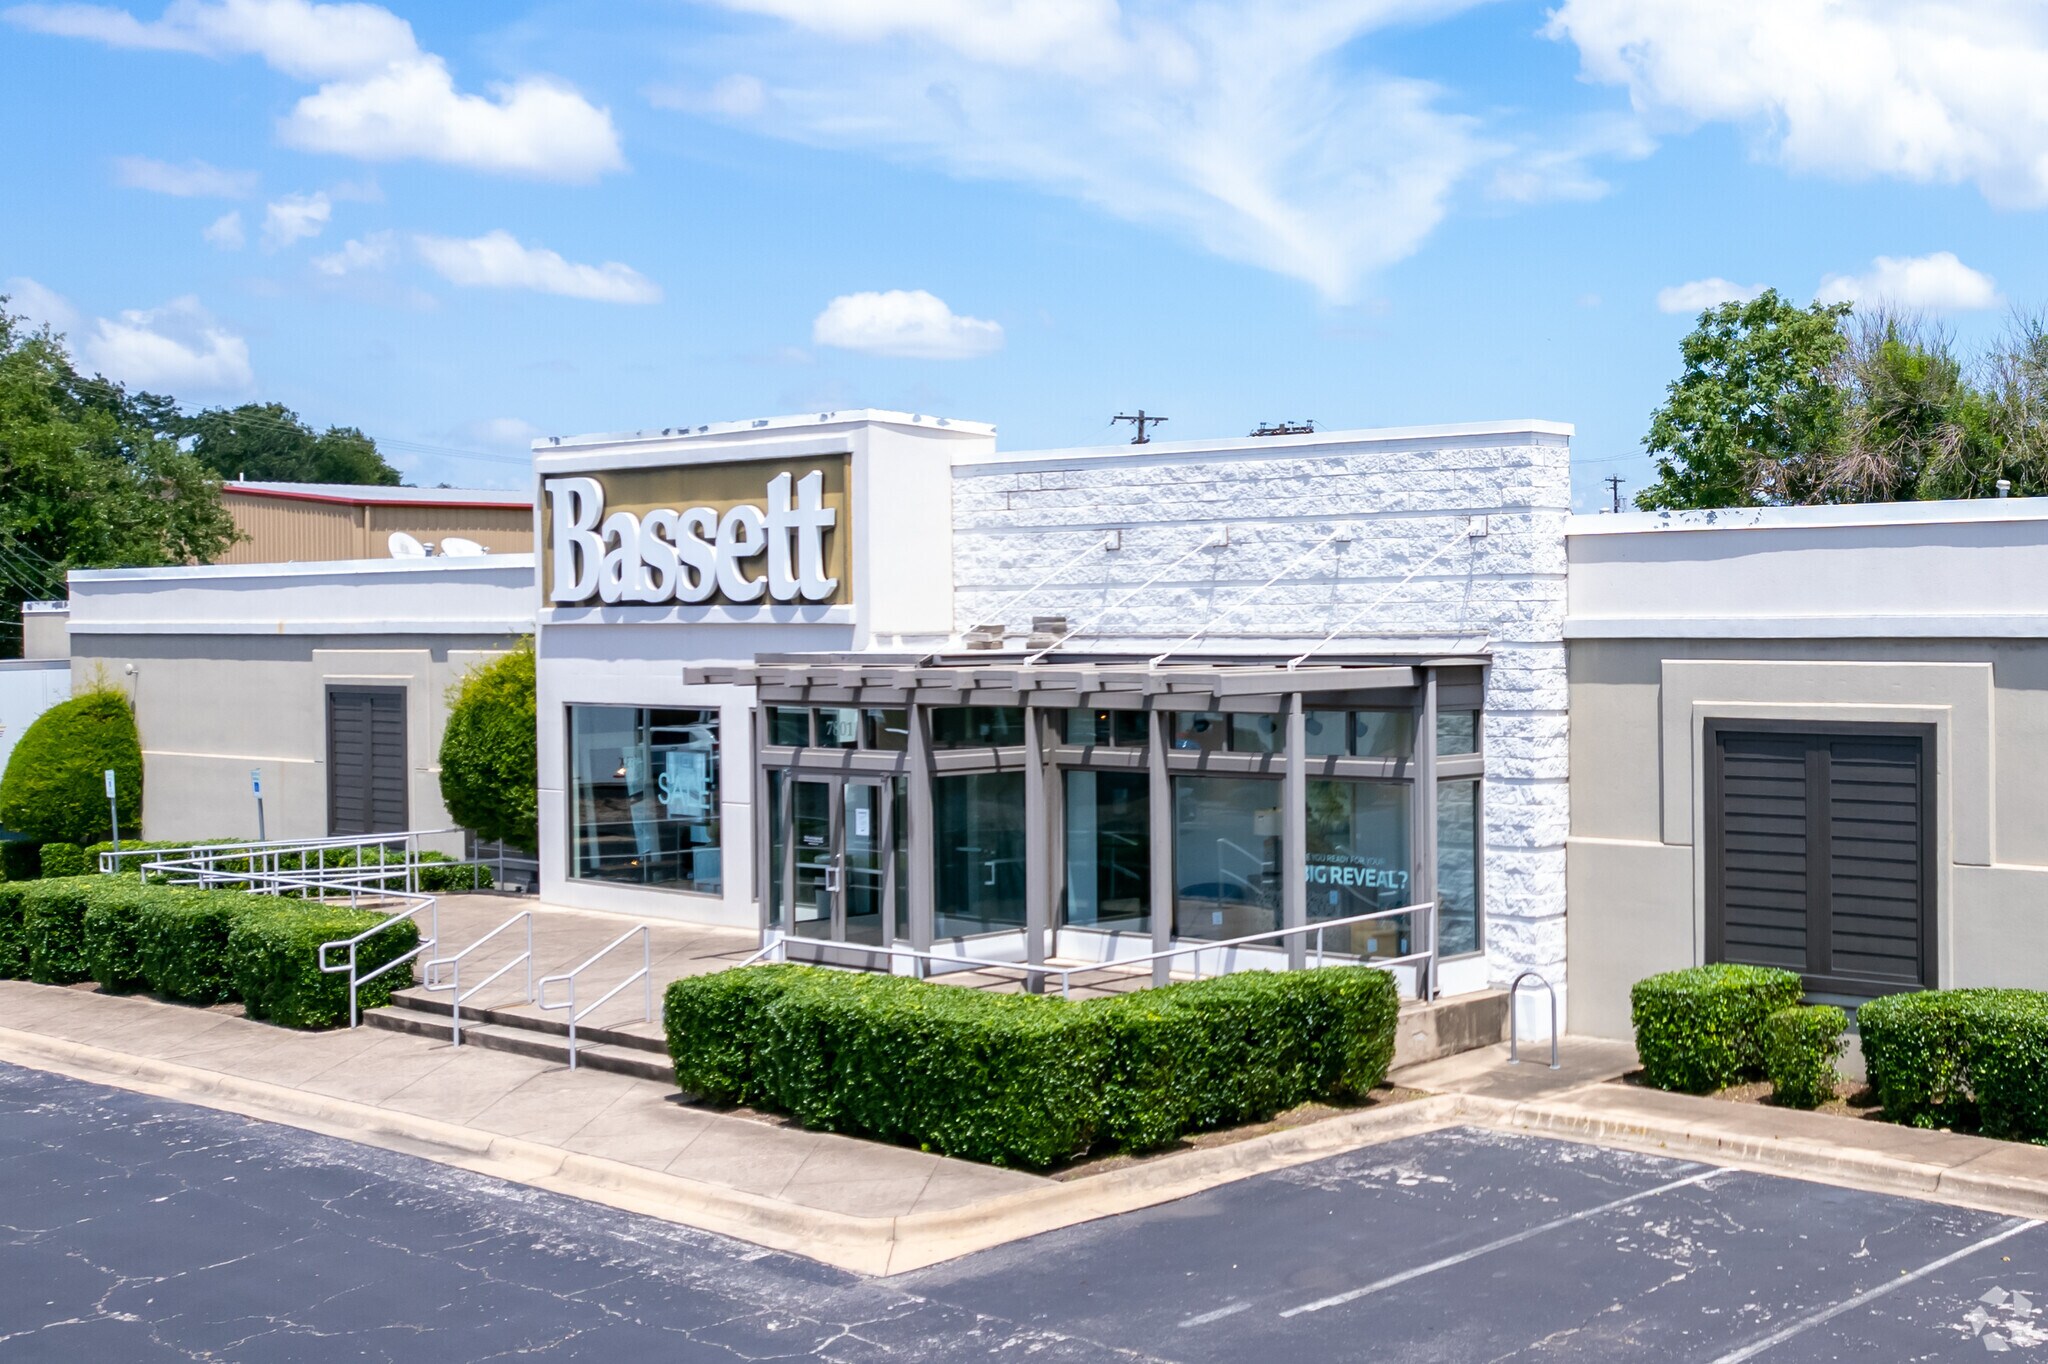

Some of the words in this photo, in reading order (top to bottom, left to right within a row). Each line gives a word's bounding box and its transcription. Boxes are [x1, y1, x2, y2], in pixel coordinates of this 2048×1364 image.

[545, 470, 838, 603] Bassett
[826, 720, 852, 736] 7801
[658, 772, 710, 809] SALE
[1311, 853, 1326, 862] YOU
[1327, 853, 1349, 863] READY
[1350, 855, 1366, 865] FOR
[1330, 866, 1408, 889] REVEAL?
